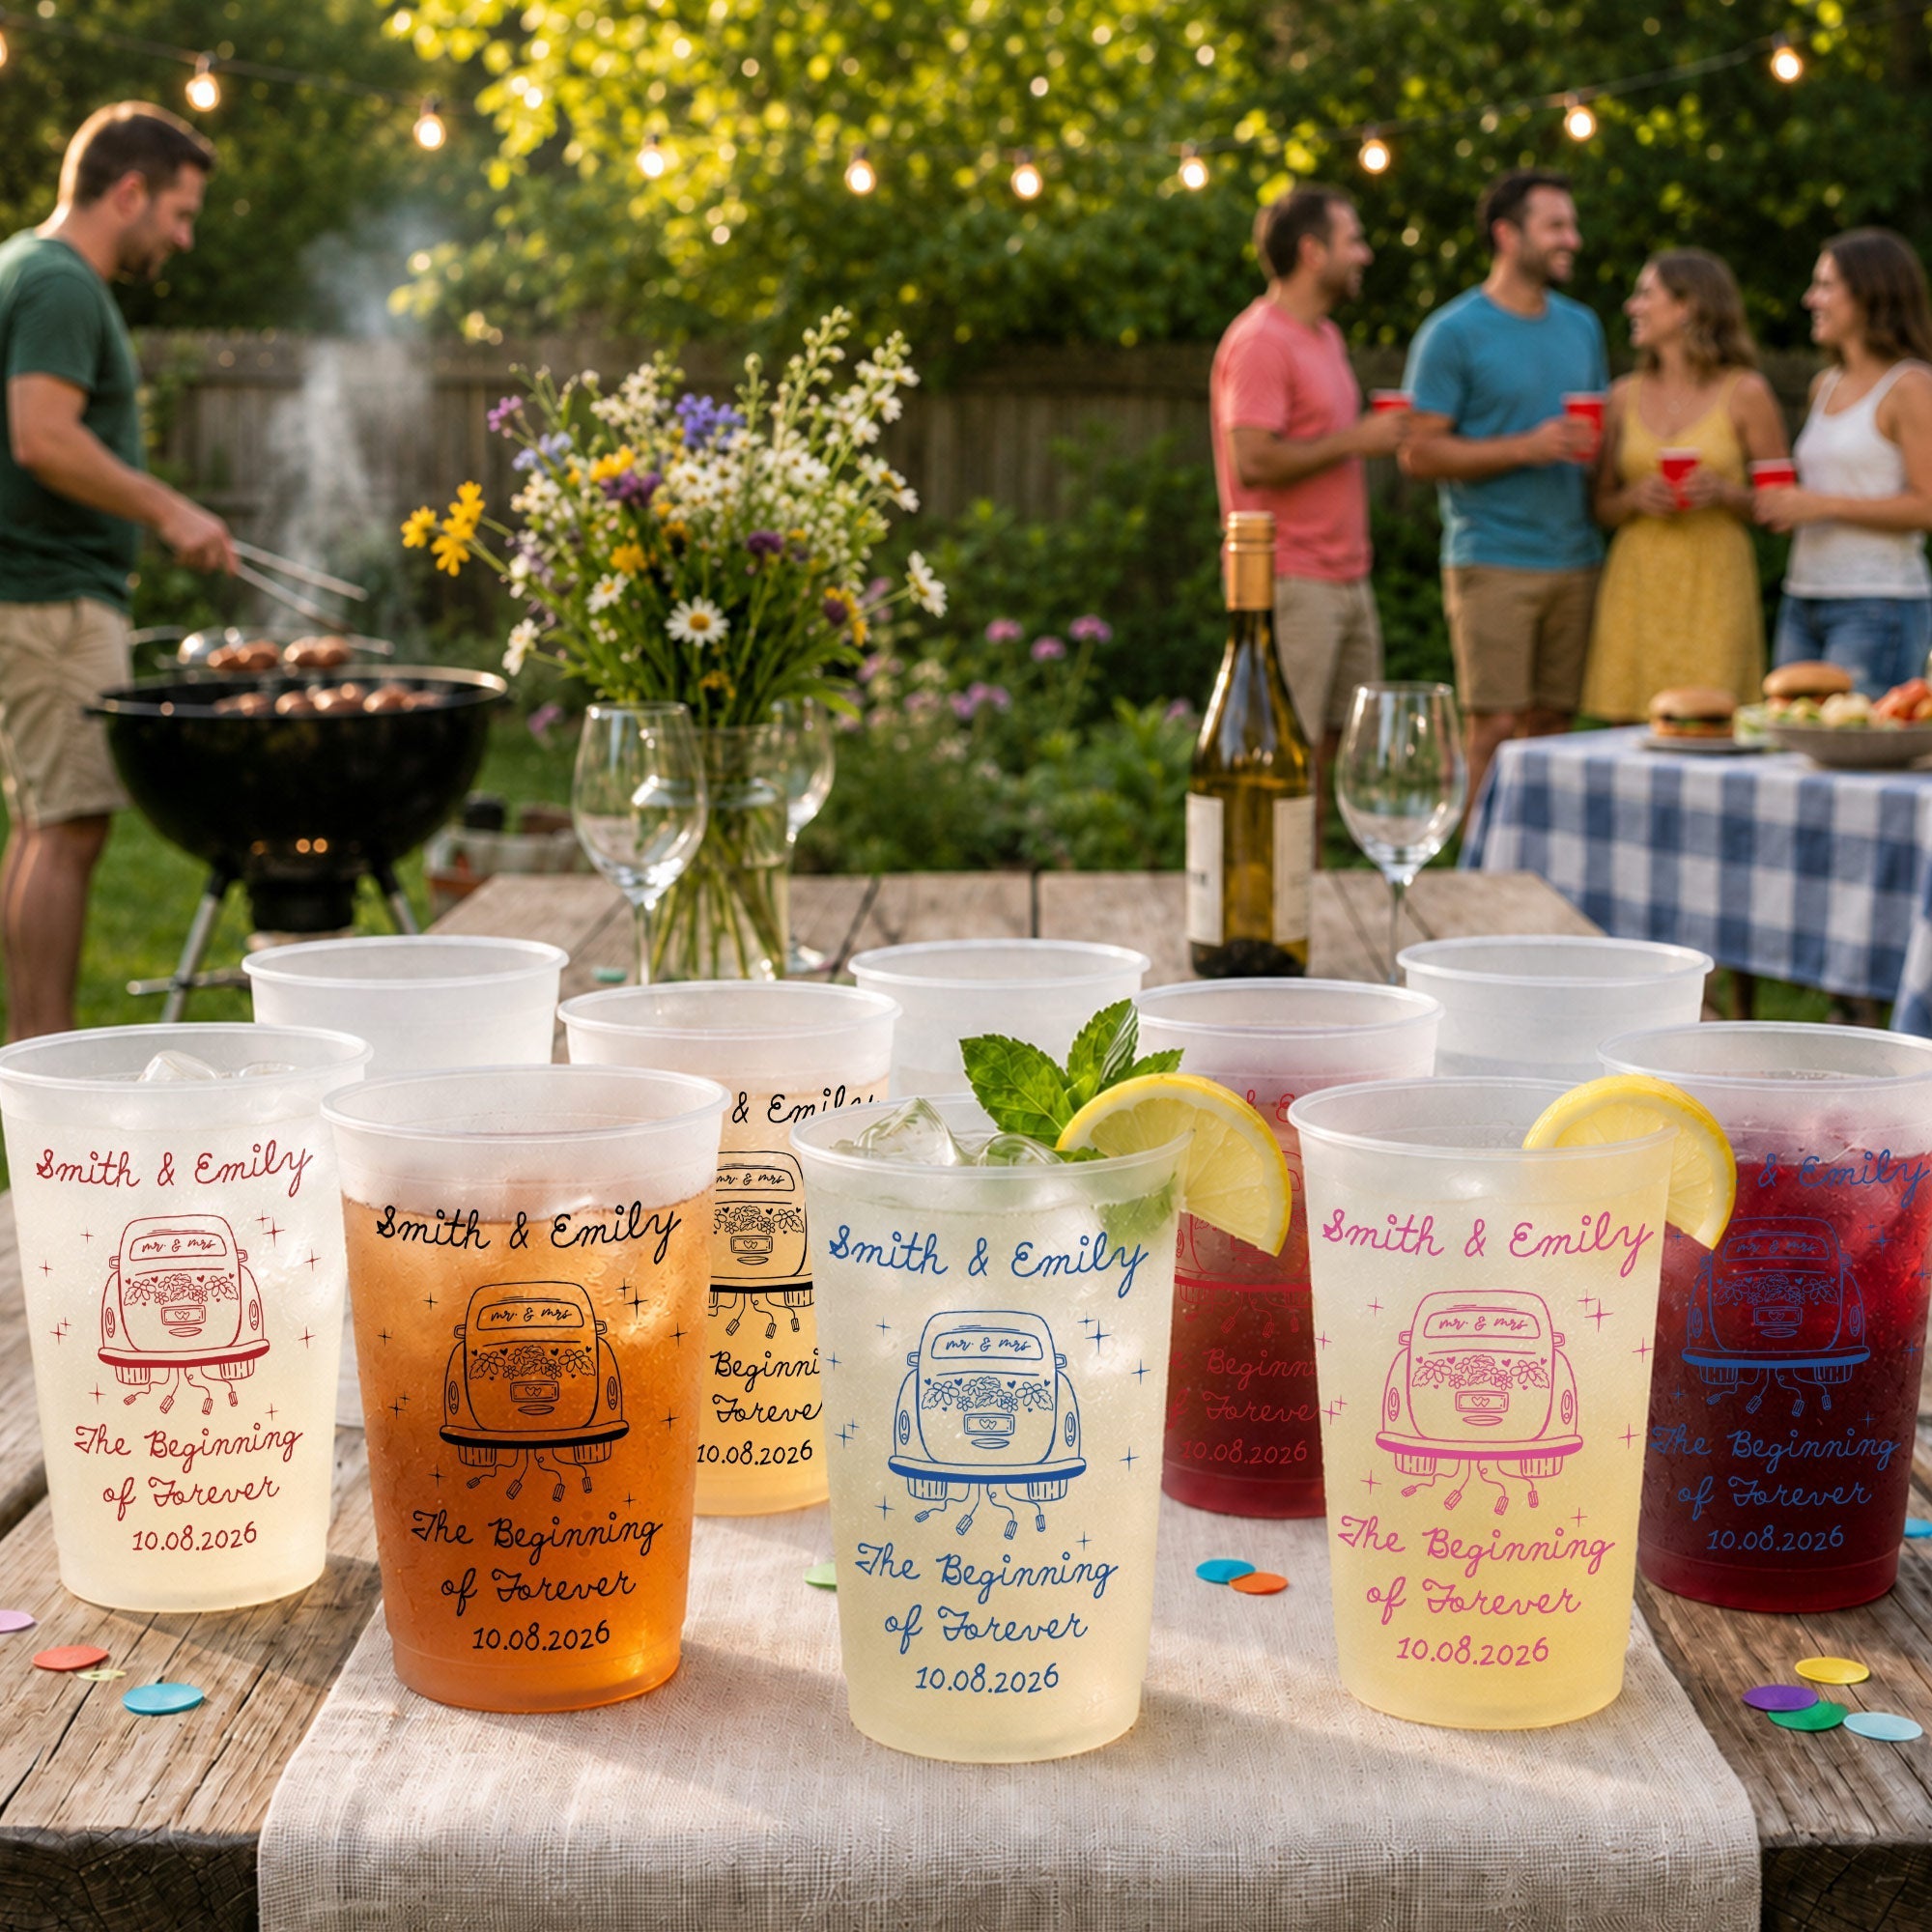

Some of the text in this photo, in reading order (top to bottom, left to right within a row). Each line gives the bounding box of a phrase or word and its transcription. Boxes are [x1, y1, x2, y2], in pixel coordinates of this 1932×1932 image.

[731, 1084, 880, 1124] & Emil
[36, 1139, 314, 1199] Smith & Emily
[742, 1173, 753, 1186] &
[1757, 1149, 1931, 1209] & Emily
[171, 1238, 182, 1253] &
[376, 1200, 682, 1265] Smith & Emily
[1321, 1208, 1655, 1279] Smith & Emily
[829, 1224, 1150, 1299] Smith & Emily
[523, 1306, 535, 1322] &
[1474, 1316, 1487, 1332] &
[980, 1336, 992, 1352] &
[709, 1348, 820, 1393] Beginni
[712, 1394, 823, 1423] Foreve
[1167, 1387, 1321, 1431] f Foreve
[72, 1422, 303, 1474] The Beginning
[696, 1438, 813, 1466] 10.08.2026
[1181, 1437, 1308, 1465] 10.08.2026
[1649, 1423, 1902, 1474] The Beginning
[102, 1476, 281, 1522] of Forever
[1677, 1475, 1872, 1521] of Forever
[131, 1525, 259, 1553] 10.08.2026
[411, 1508, 664, 1567] The Beginning
[1337, 1515, 1616, 1579] The Beginning
[1706, 1523, 1844, 1551] 10.08.2026
[440, 1567, 637, 1617] of Forever
[854, 1542, 1120, 1605] The Beginning
[1366, 1576, 1582, 1626] of Forever
[471, 1619, 611, 1652] 10.08.2026
[884, 1604, 1089, 1656] of Forever
[1396, 1634, 1549, 1667] 10.08.2026
[914, 1662, 1060, 1694] 10.08.2026
